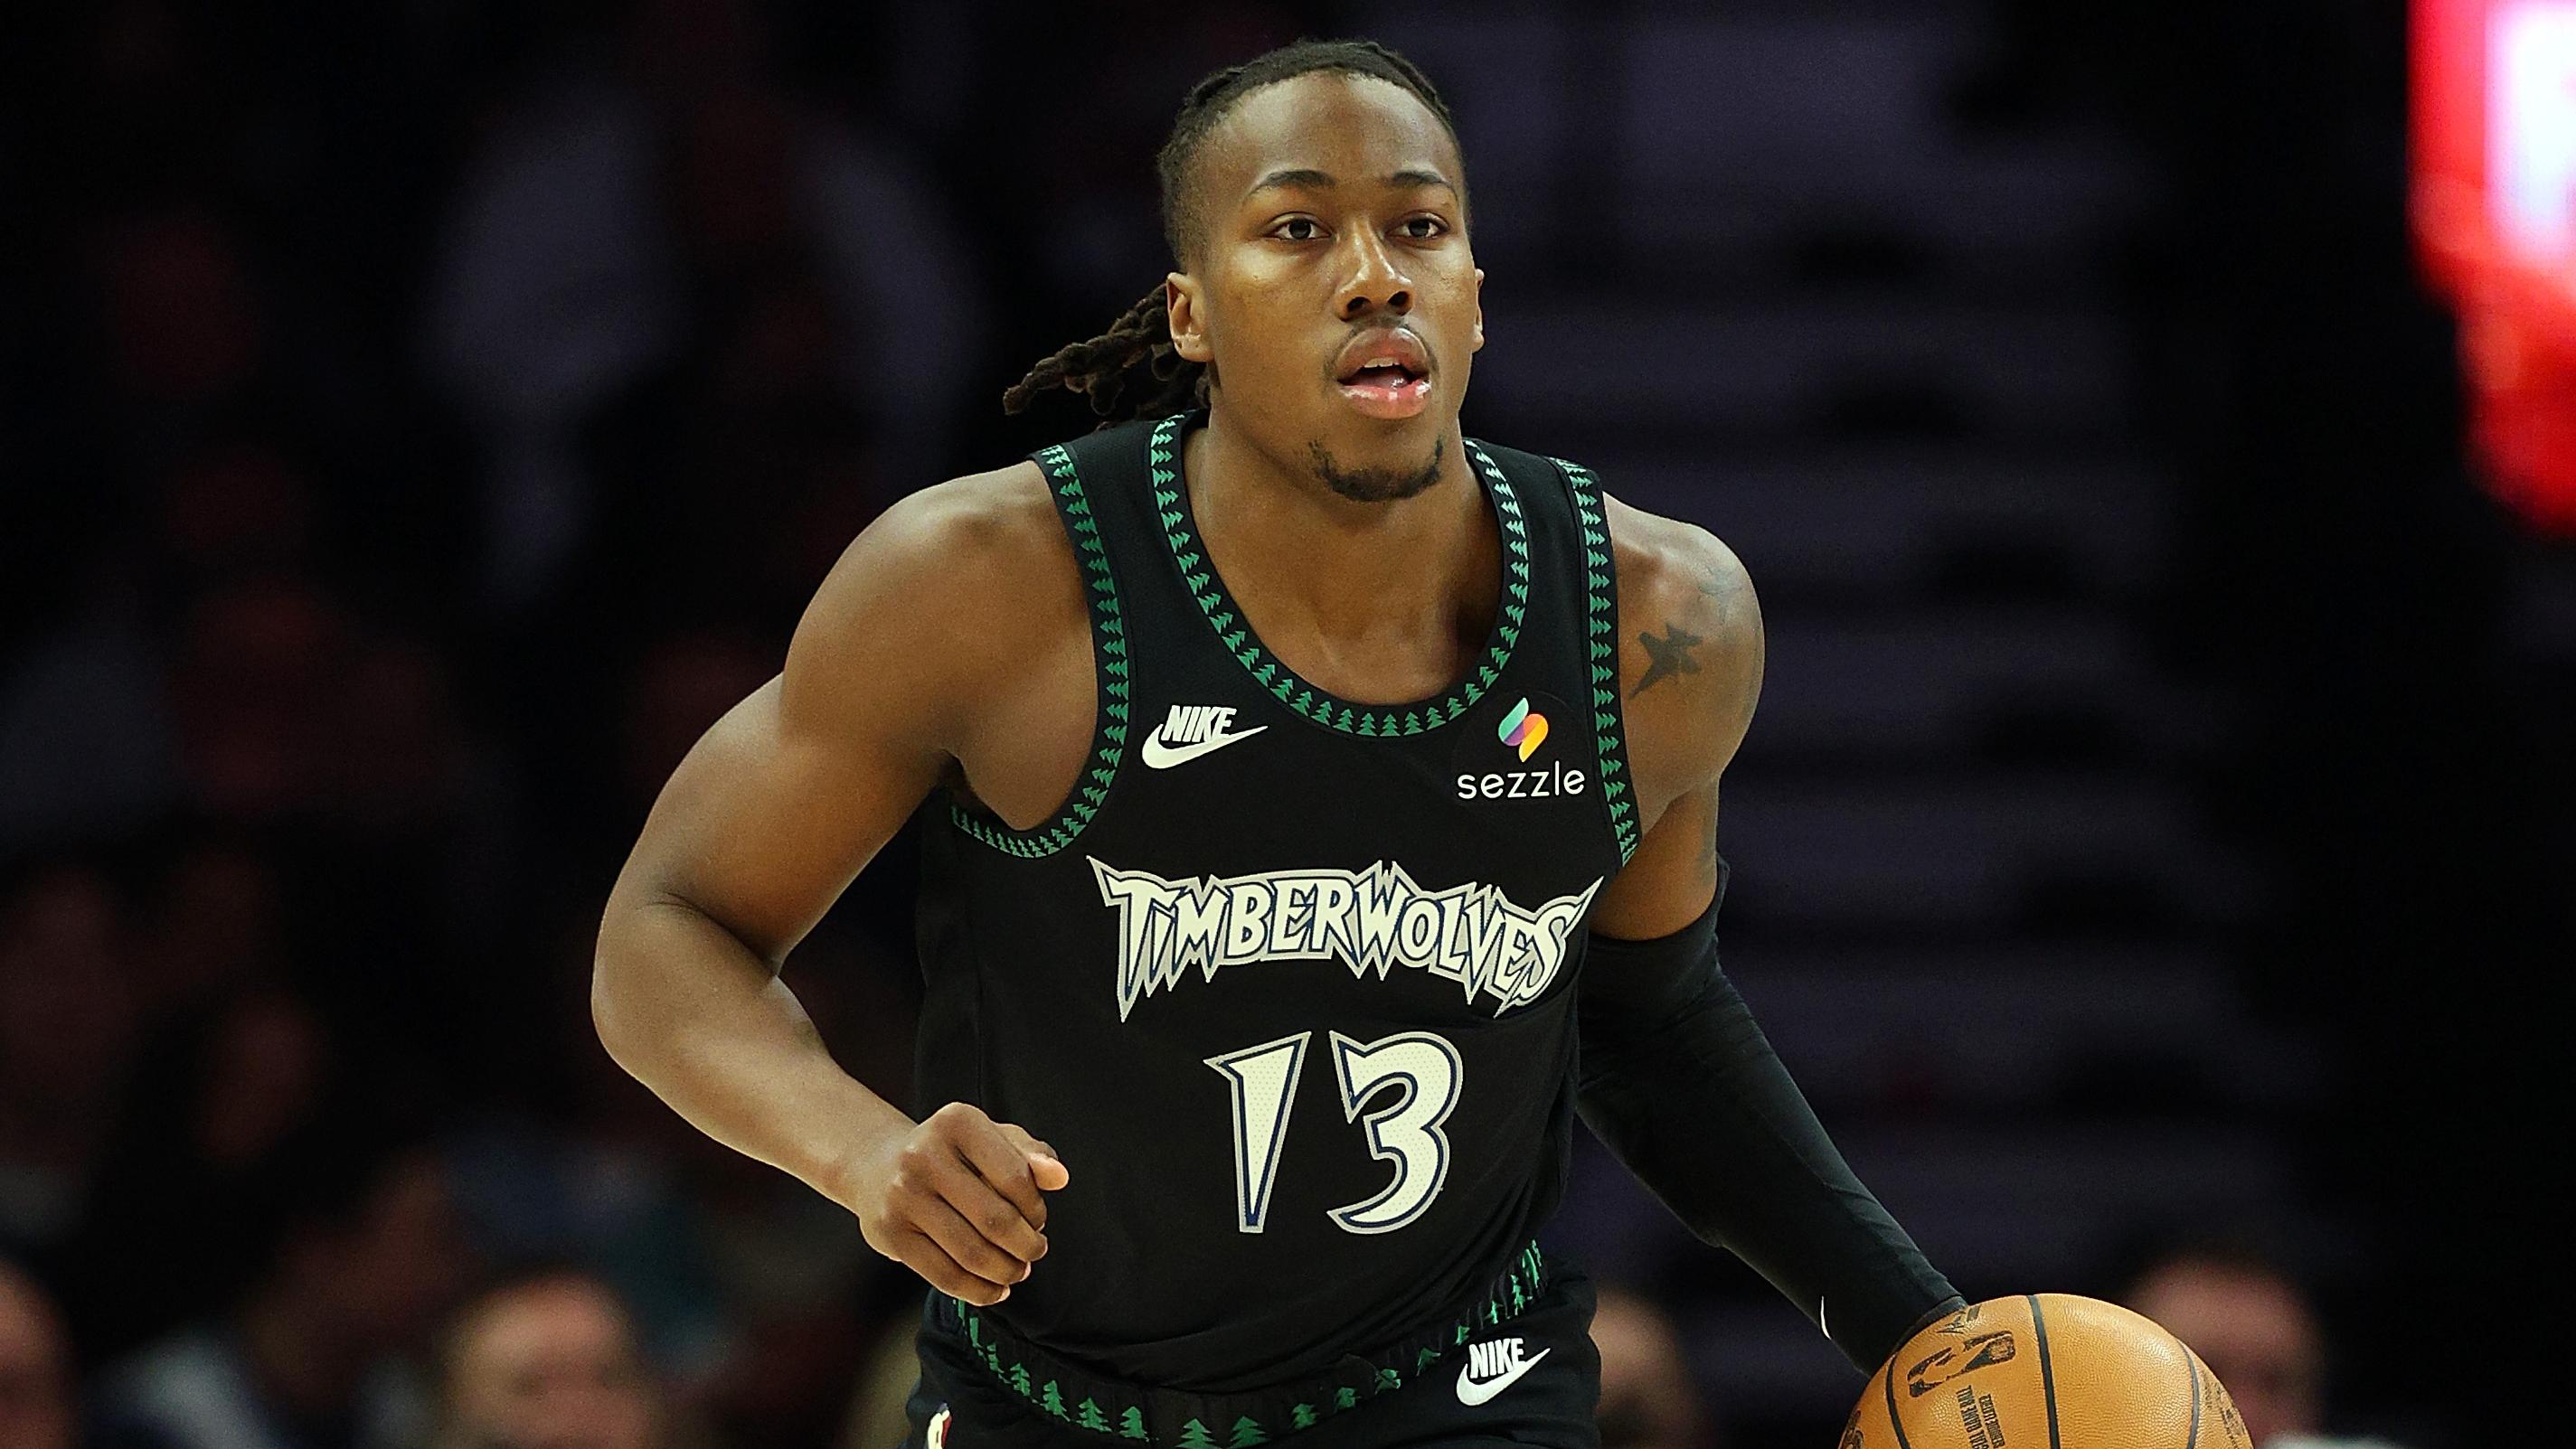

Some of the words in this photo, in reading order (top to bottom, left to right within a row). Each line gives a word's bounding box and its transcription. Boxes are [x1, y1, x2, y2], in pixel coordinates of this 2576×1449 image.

[1160, 705, 1238, 742] NIKE
[1457, 760, 1586, 799] sezzle
[1087, 854, 1605, 1022] TIMBERWOLVES
[1203, 1030, 1463, 1235] 13
[1468, 1337, 1525, 1379] NIKE
